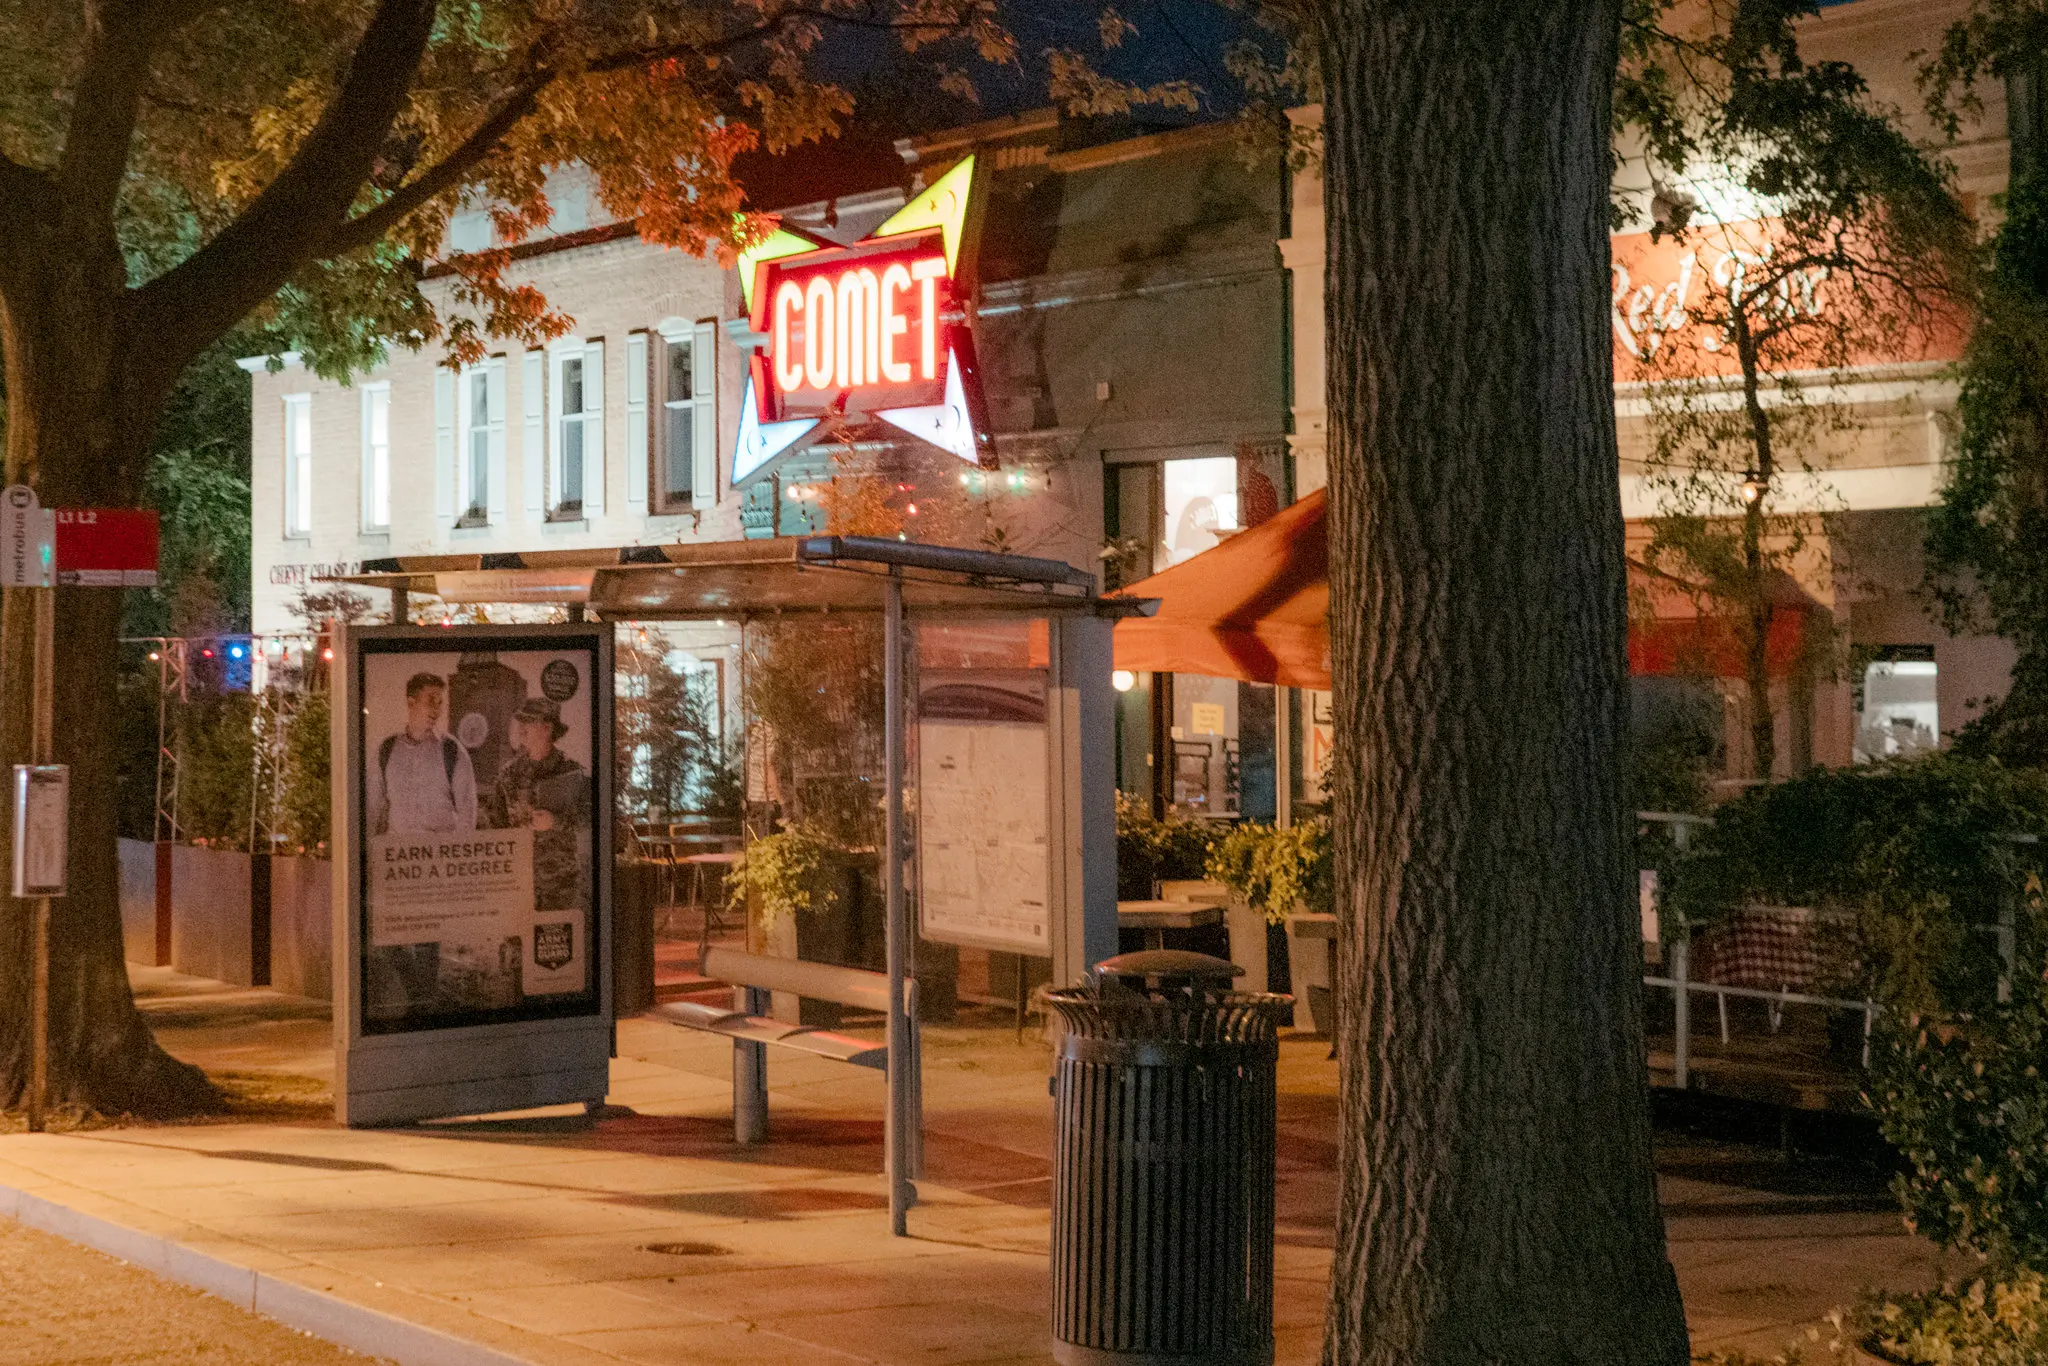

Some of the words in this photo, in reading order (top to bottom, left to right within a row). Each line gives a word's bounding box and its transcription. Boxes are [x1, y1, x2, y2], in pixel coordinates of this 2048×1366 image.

[775, 257, 947, 392] COMET
[1612, 252, 1696, 358] Red
[78, 511, 97, 524] L2
[13, 512, 26, 583] metrobus
[385, 846, 433, 863] EARN
[439, 841, 517, 859] RESPECT
[385, 866, 422, 881] AND
[428, 865, 440, 878] A
[446, 860, 514, 877] DEGREE
